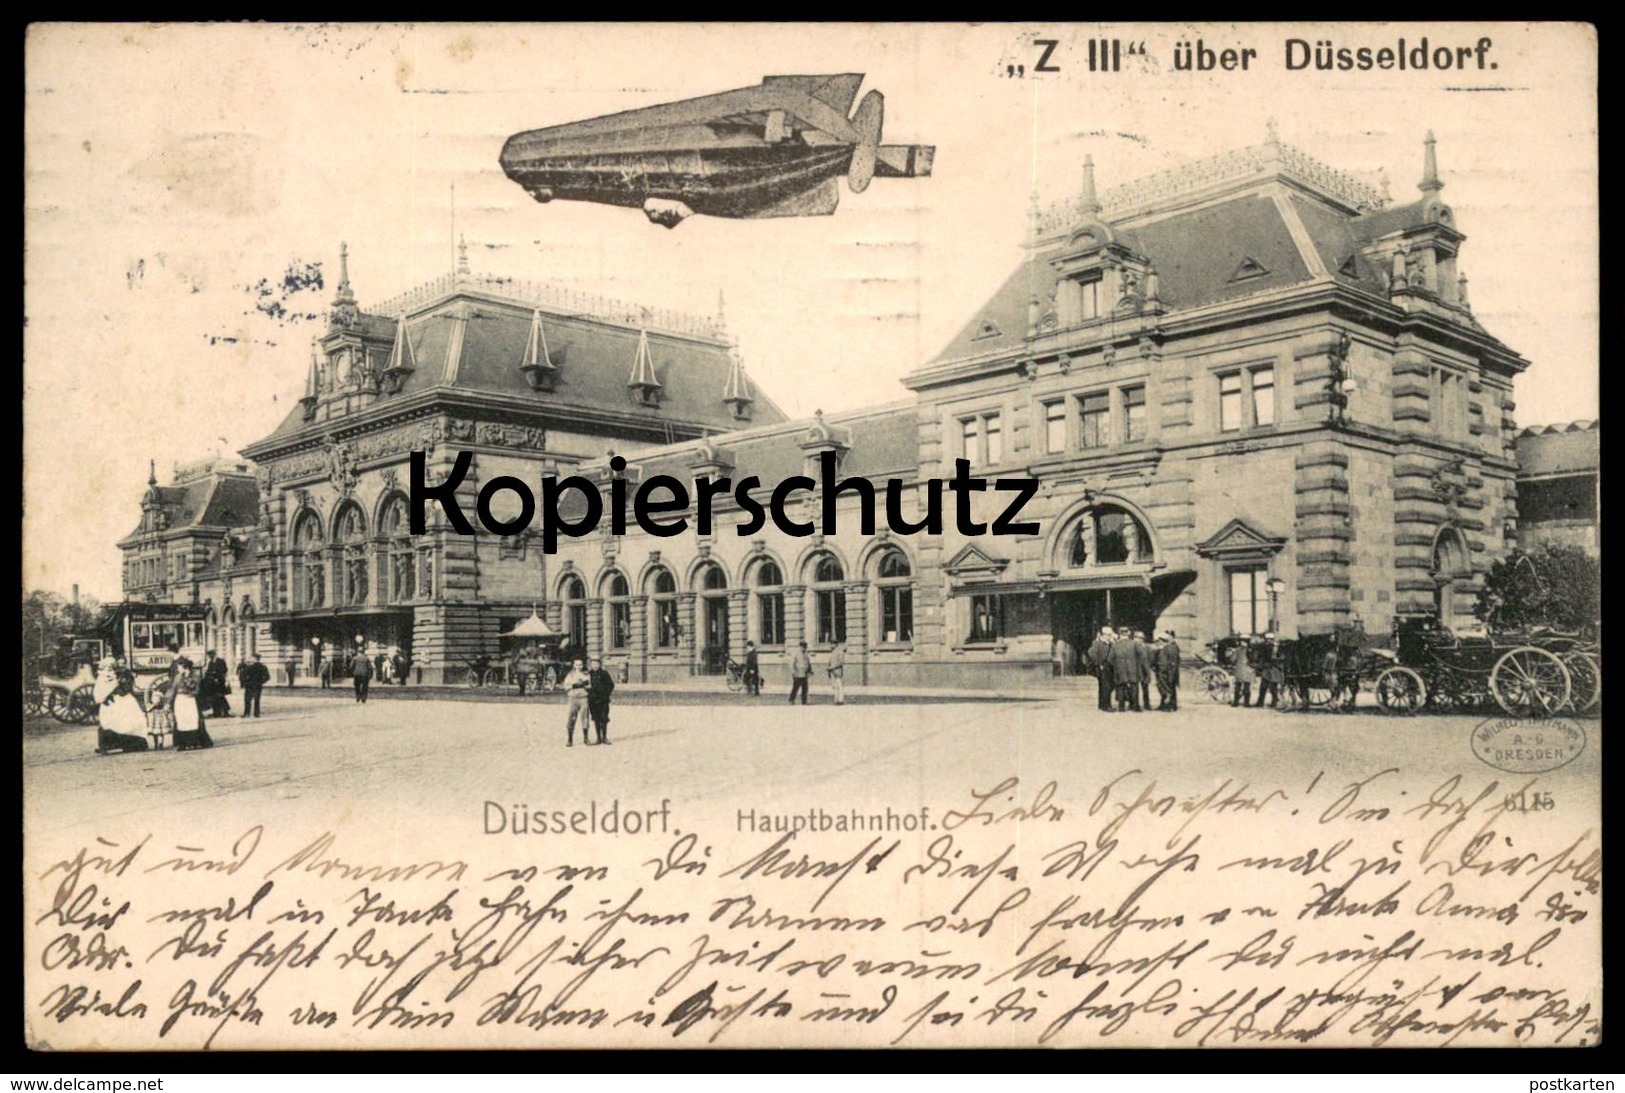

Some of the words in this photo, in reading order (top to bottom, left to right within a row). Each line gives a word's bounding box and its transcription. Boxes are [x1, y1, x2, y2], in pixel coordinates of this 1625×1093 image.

[1173, 38, 1257, 72] über
[1285, 37, 1499, 72] Düsseldorf.
[1495, 748, 1564, 761] DRESDEN
[483, 799, 682, 836] Düsseldorf.
[736, 808, 938, 839] Hauptbahnhof.
